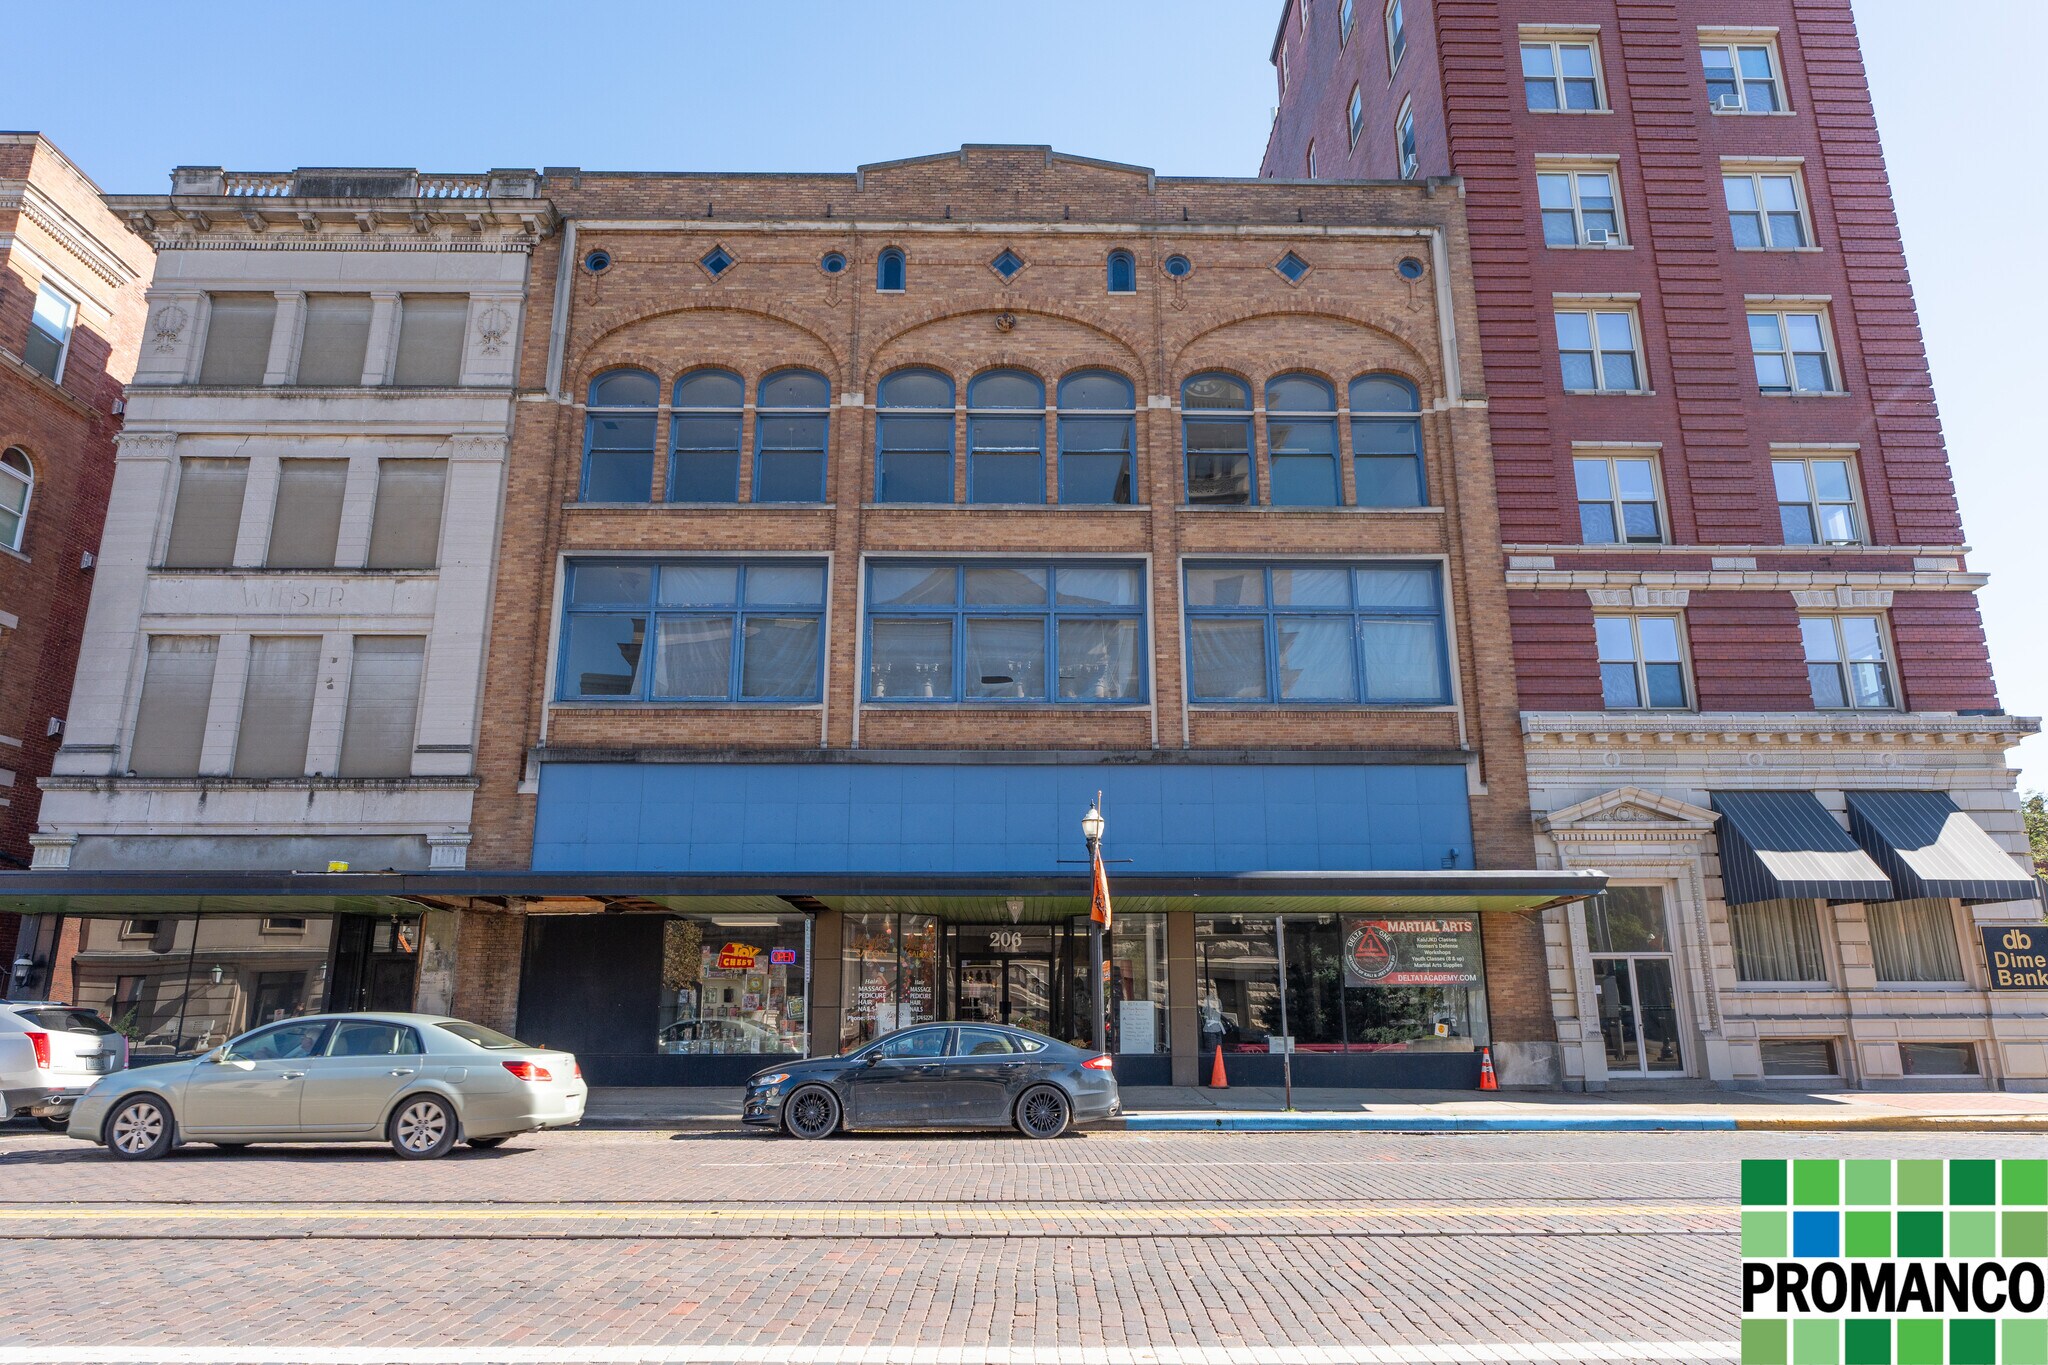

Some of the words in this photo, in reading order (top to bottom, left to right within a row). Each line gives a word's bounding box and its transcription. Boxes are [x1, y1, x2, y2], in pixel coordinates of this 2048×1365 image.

[243, 587, 345, 607] WIESER
[1388, 921, 1440, 932] MARTIAL
[1442, 921, 1472, 932] ARTS
[989, 932, 1022, 947] 206
[1347, 930, 1363, 947] DELTA
[1378, 930, 1392, 943] ONE
[2002, 929, 2031, 950] db
[723, 958, 752, 966] CHEST
[772, 952, 794, 962] OPEN
[1994, 952, 2046, 968] Dime
[1397, 974, 1477, 982] DELTA1ACADEMY.COM
[1998, 969, 2048, 986] Bank
